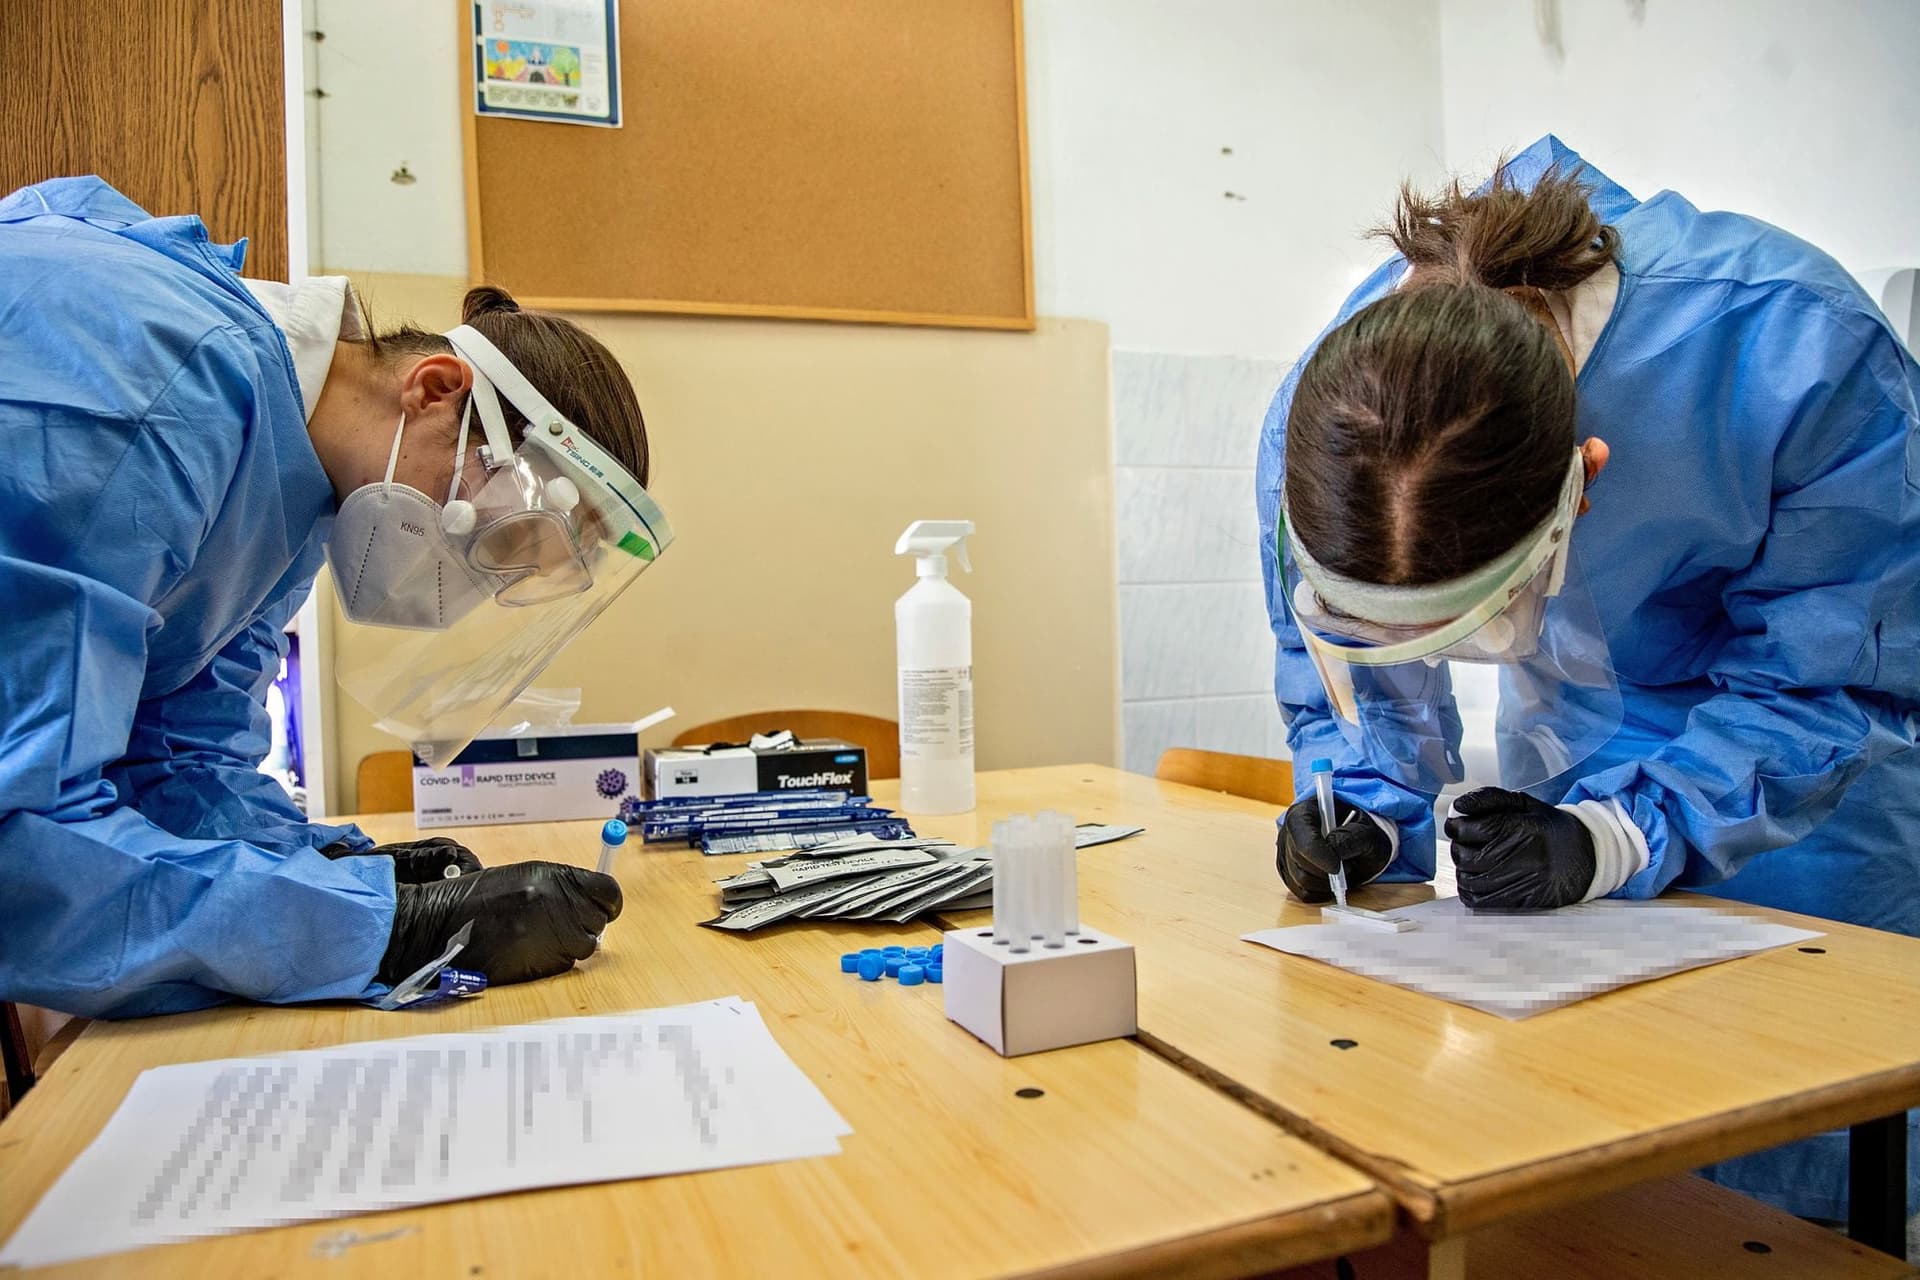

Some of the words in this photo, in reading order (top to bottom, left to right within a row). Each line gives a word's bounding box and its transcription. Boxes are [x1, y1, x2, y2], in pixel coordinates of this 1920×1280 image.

[566, 447, 590, 468] TSING
[400, 521, 425, 536] KN95
[420, 776, 460, 786] COVID-19
[476, 775, 503, 783] RAPID
[505, 773, 523, 782] TEST
[525, 772, 556, 781] DEVICE
[777, 772, 852, 788] TouchFlex
